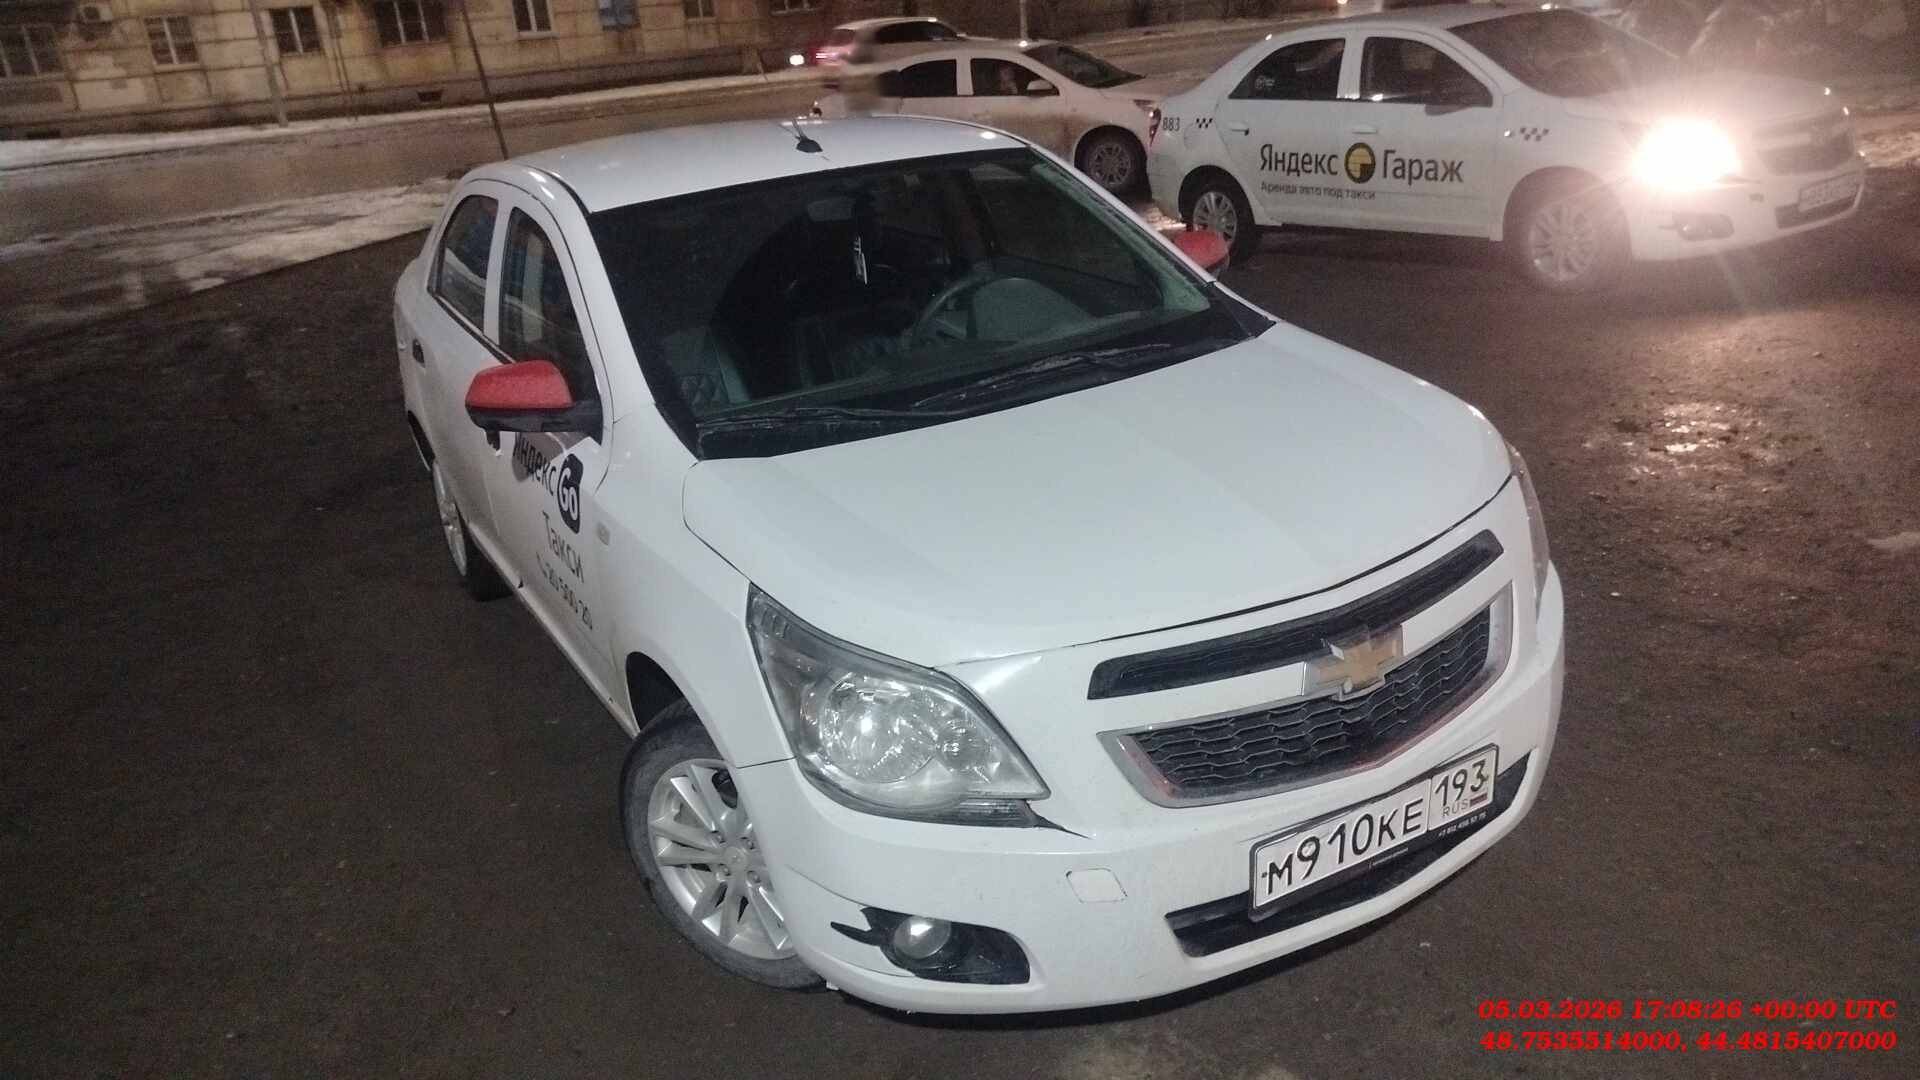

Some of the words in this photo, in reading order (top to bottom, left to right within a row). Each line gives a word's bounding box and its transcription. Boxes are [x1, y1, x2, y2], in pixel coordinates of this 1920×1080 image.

[1259, 143, 1338, 176] Яндекс
[1382, 149, 1464, 185] Гараж
[1345, 189, 1376, 200] такси
[558, 466, 578, 522] Go
[541, 510, 585, 584] Такси
[1434, 758, 1489, 807] 193
[1442, 798, 1469, 817] RUS
